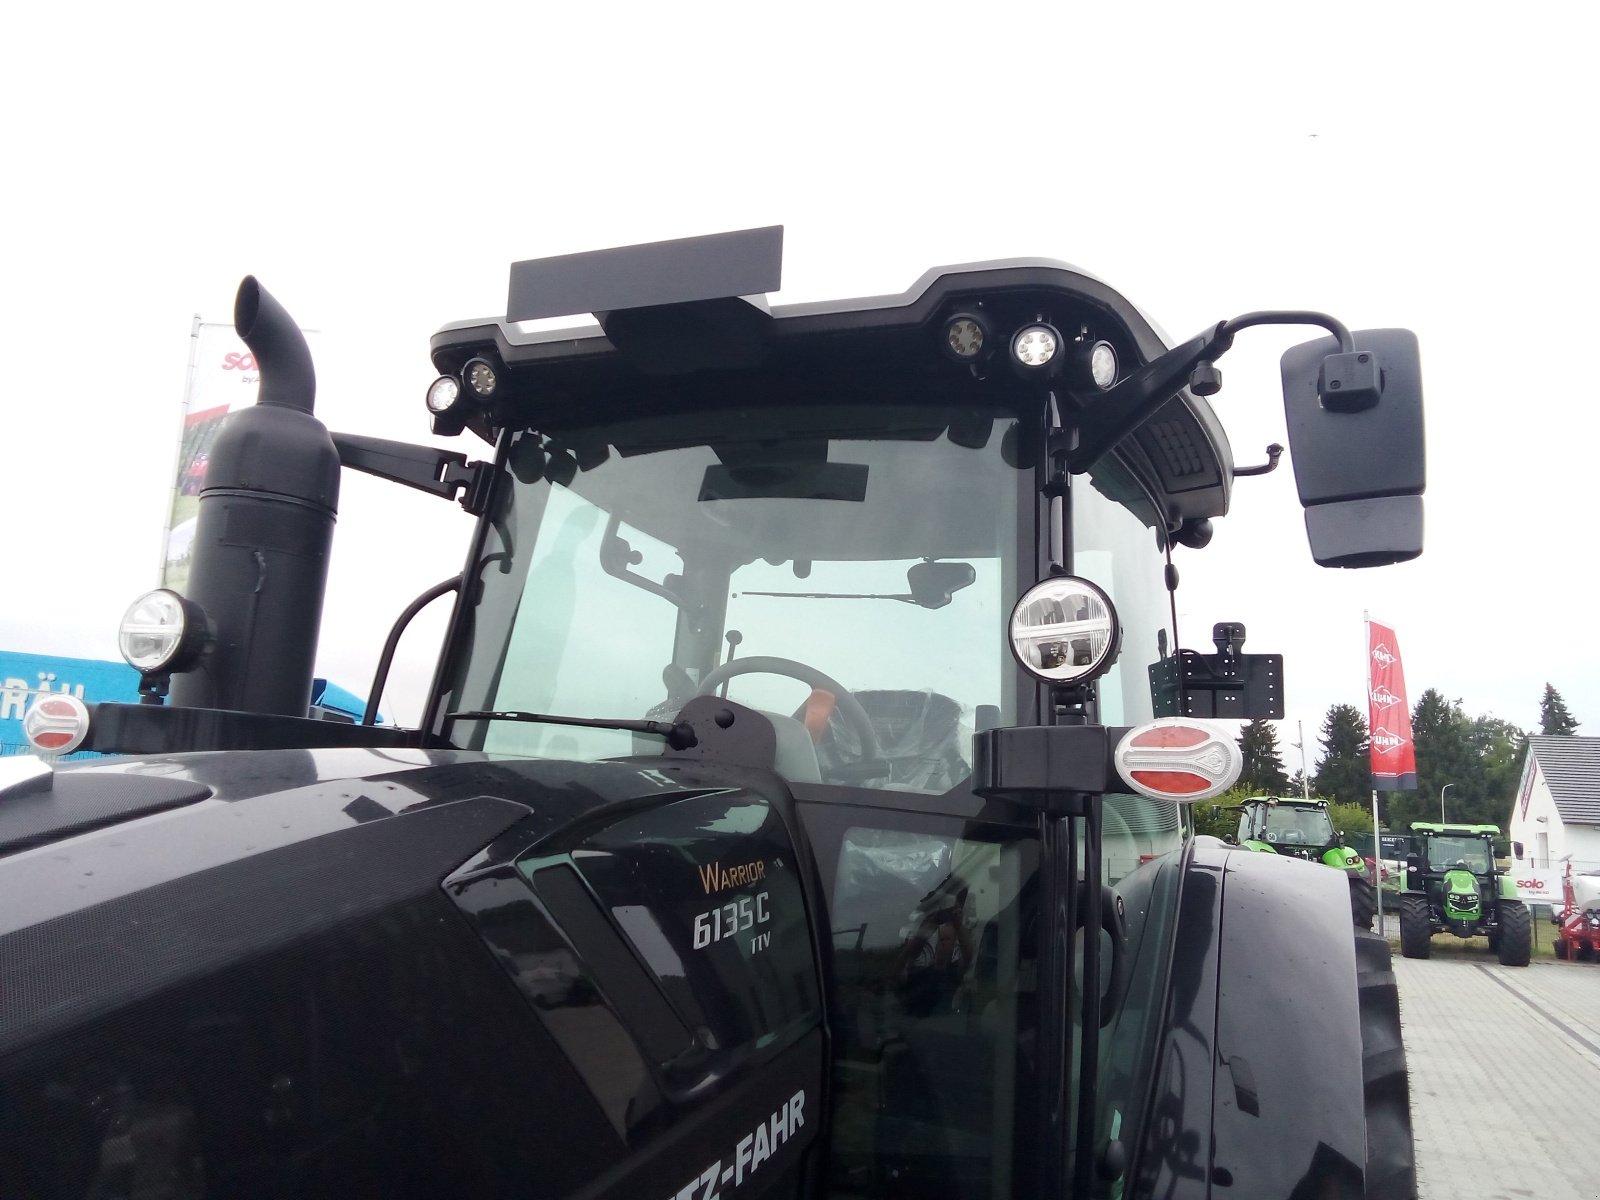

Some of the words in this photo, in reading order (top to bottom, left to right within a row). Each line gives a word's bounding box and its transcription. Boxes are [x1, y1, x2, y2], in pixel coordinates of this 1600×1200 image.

[0, 672, 84, 720] RÄ
[699, 860, 766, 895] WARRIOR
[1516, 879, 1543, 888] solo
[751, 931, 771, 955] TTV
[667, 1089, 805, 1200] TZ-FAHR
